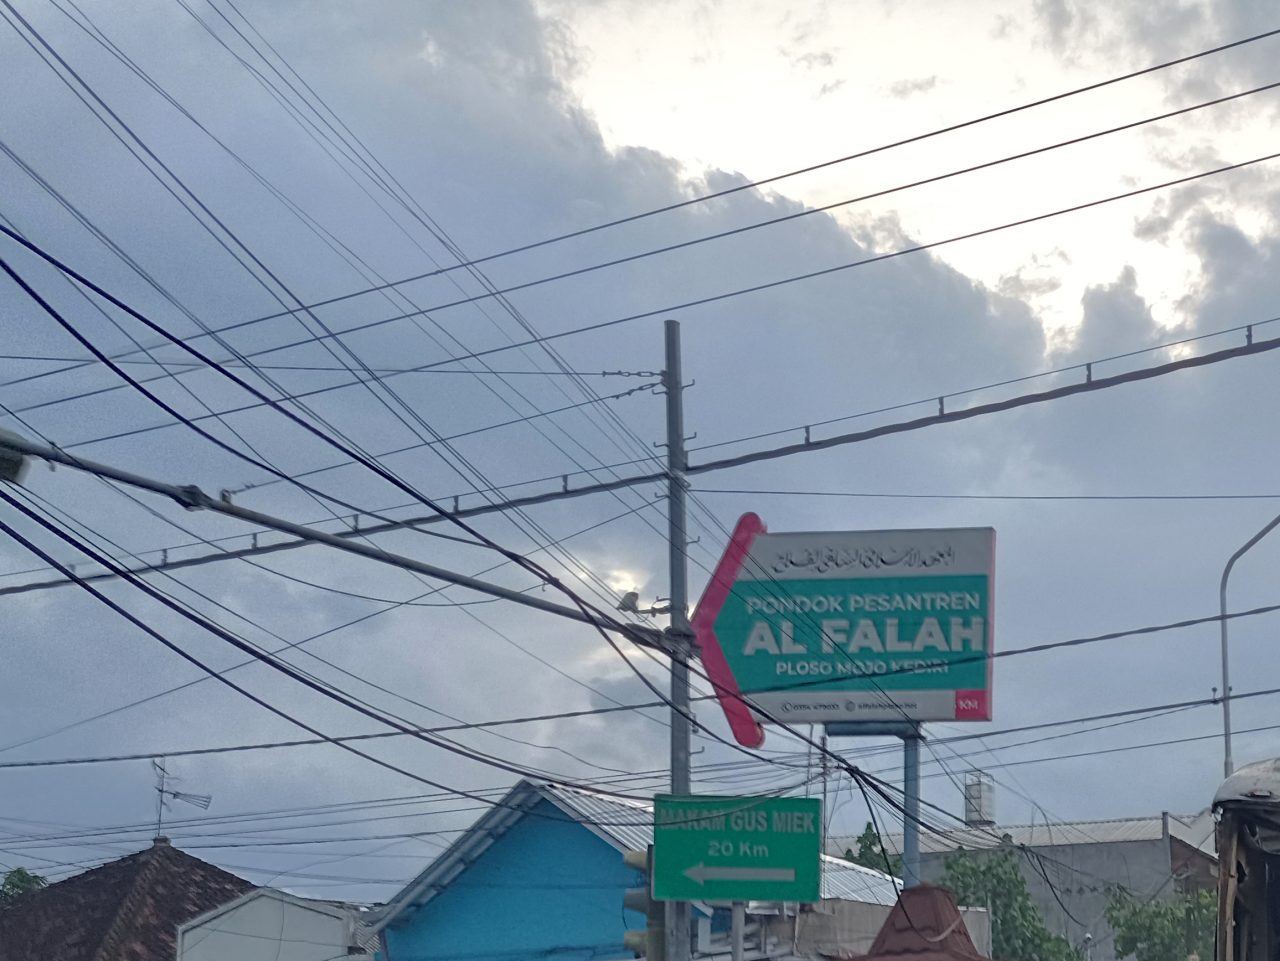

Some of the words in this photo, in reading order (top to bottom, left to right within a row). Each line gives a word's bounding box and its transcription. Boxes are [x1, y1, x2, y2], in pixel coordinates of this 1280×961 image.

[747, 596, 844, 615] PONDOK
[850, 591, 980, 612] PESANTREN
[743, 620, 807, 656] AL
[821, 617, 985, 654] FALAH
[776, 661, 833, 676] PLOSO
[836, 660, 887, 675] MOJO
[891, 659, 949, 674] KEDIRI
[959, 700, 979, 710] KM
[660, 809, 726, 831] MAKAM
[730, 811, 768, 832] GUS
[772, 811, 816, 833] MIEK
[707, 841, 733, 857] 20
[739, 843, 769, 858] Km
